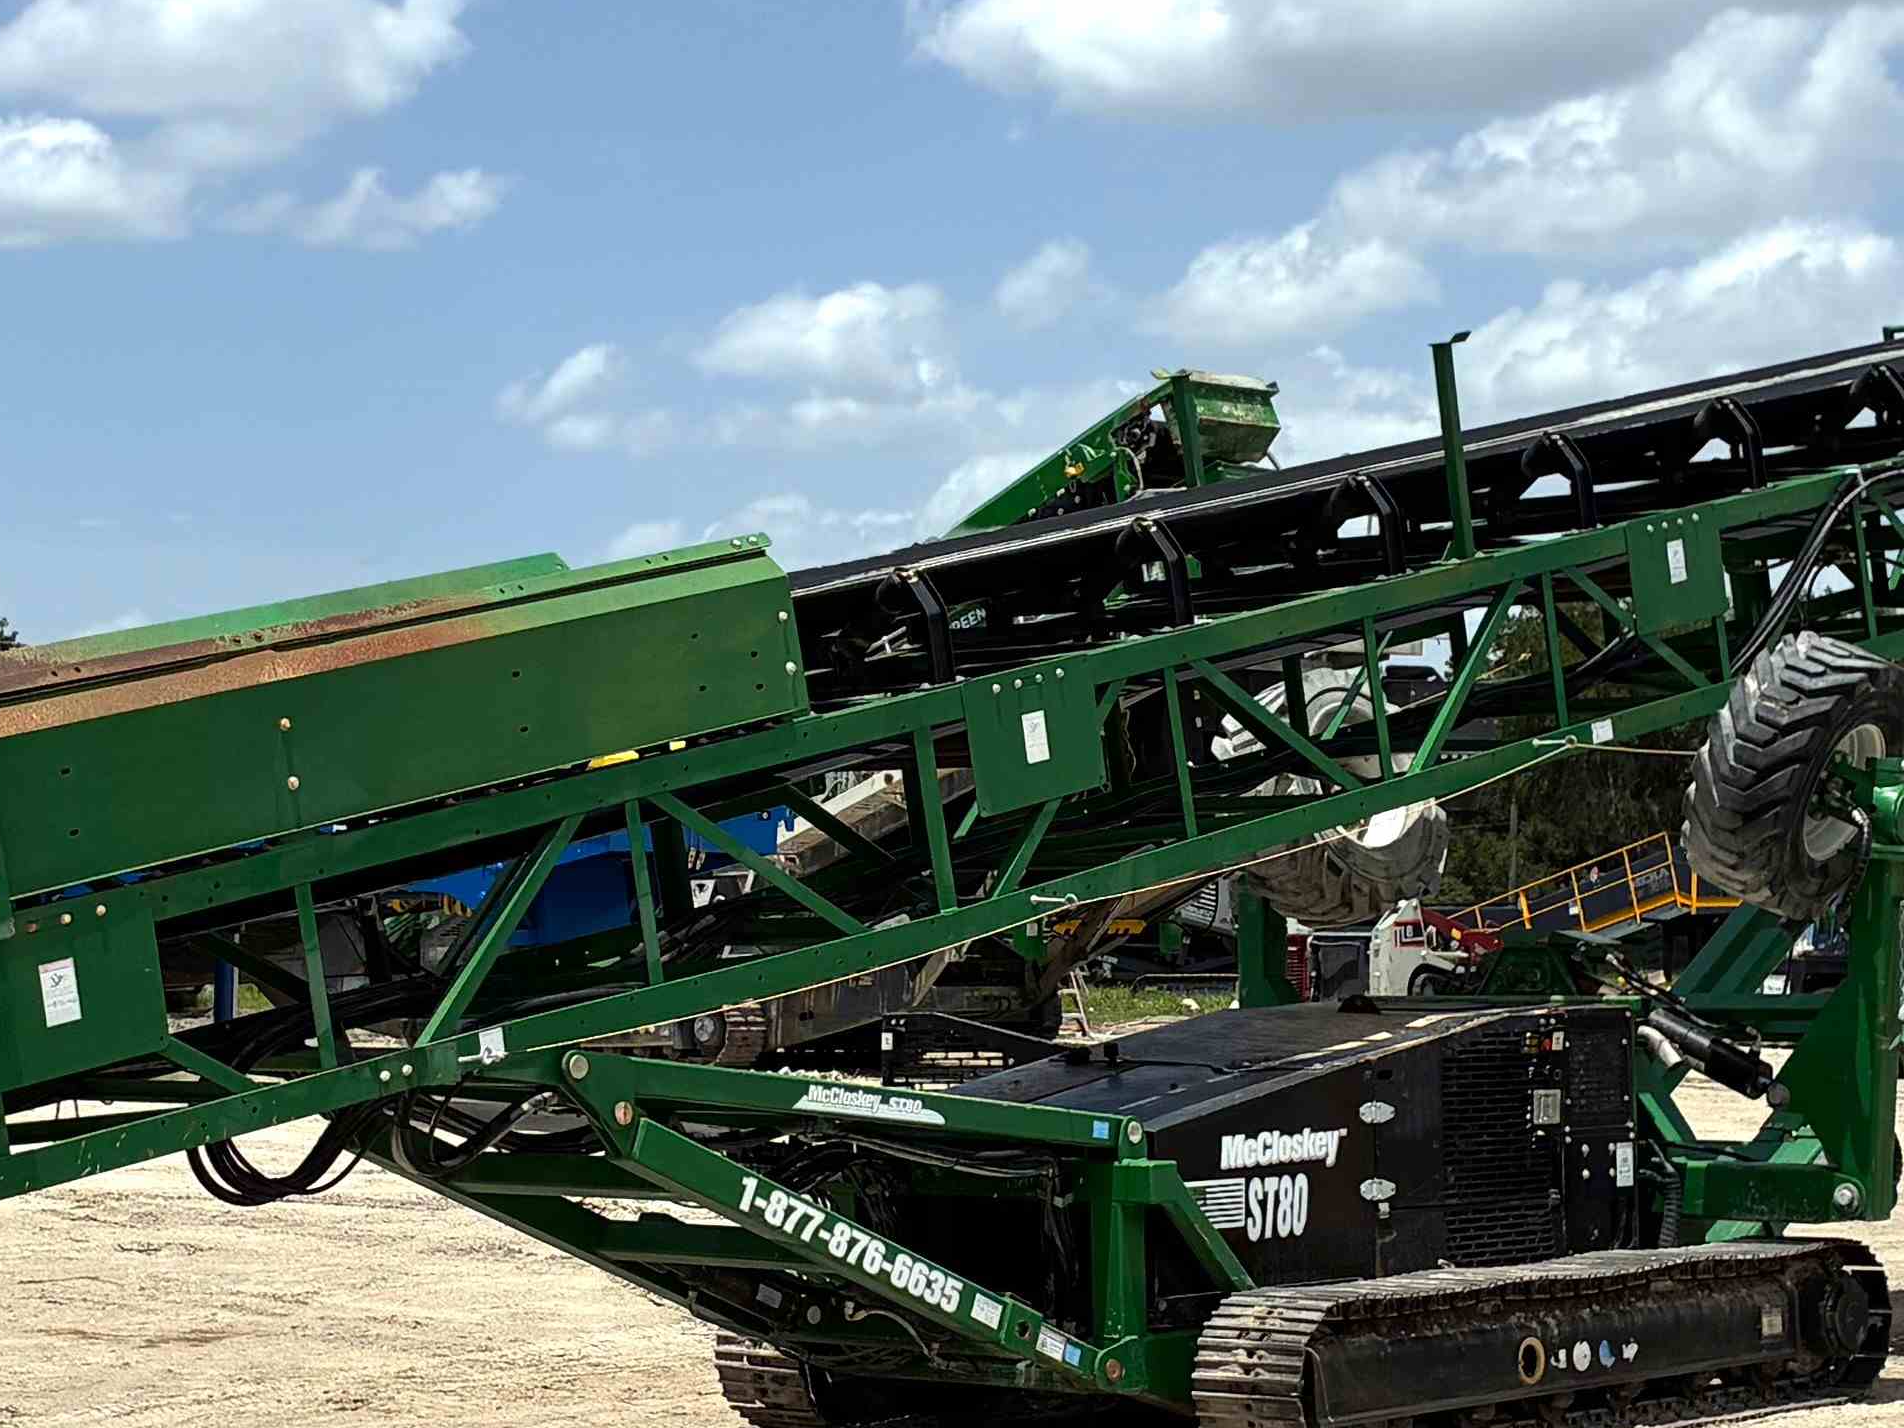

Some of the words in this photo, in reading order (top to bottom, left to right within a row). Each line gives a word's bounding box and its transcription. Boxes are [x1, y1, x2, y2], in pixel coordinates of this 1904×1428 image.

[808, 1084, 881, 1114] McCloskey
[1220, 1127, 1342, 1170] McCloskey
[1247, 1173, 1309, 1243] ST80
[739, 1176, 964, 1314] 1-877-876-6635
